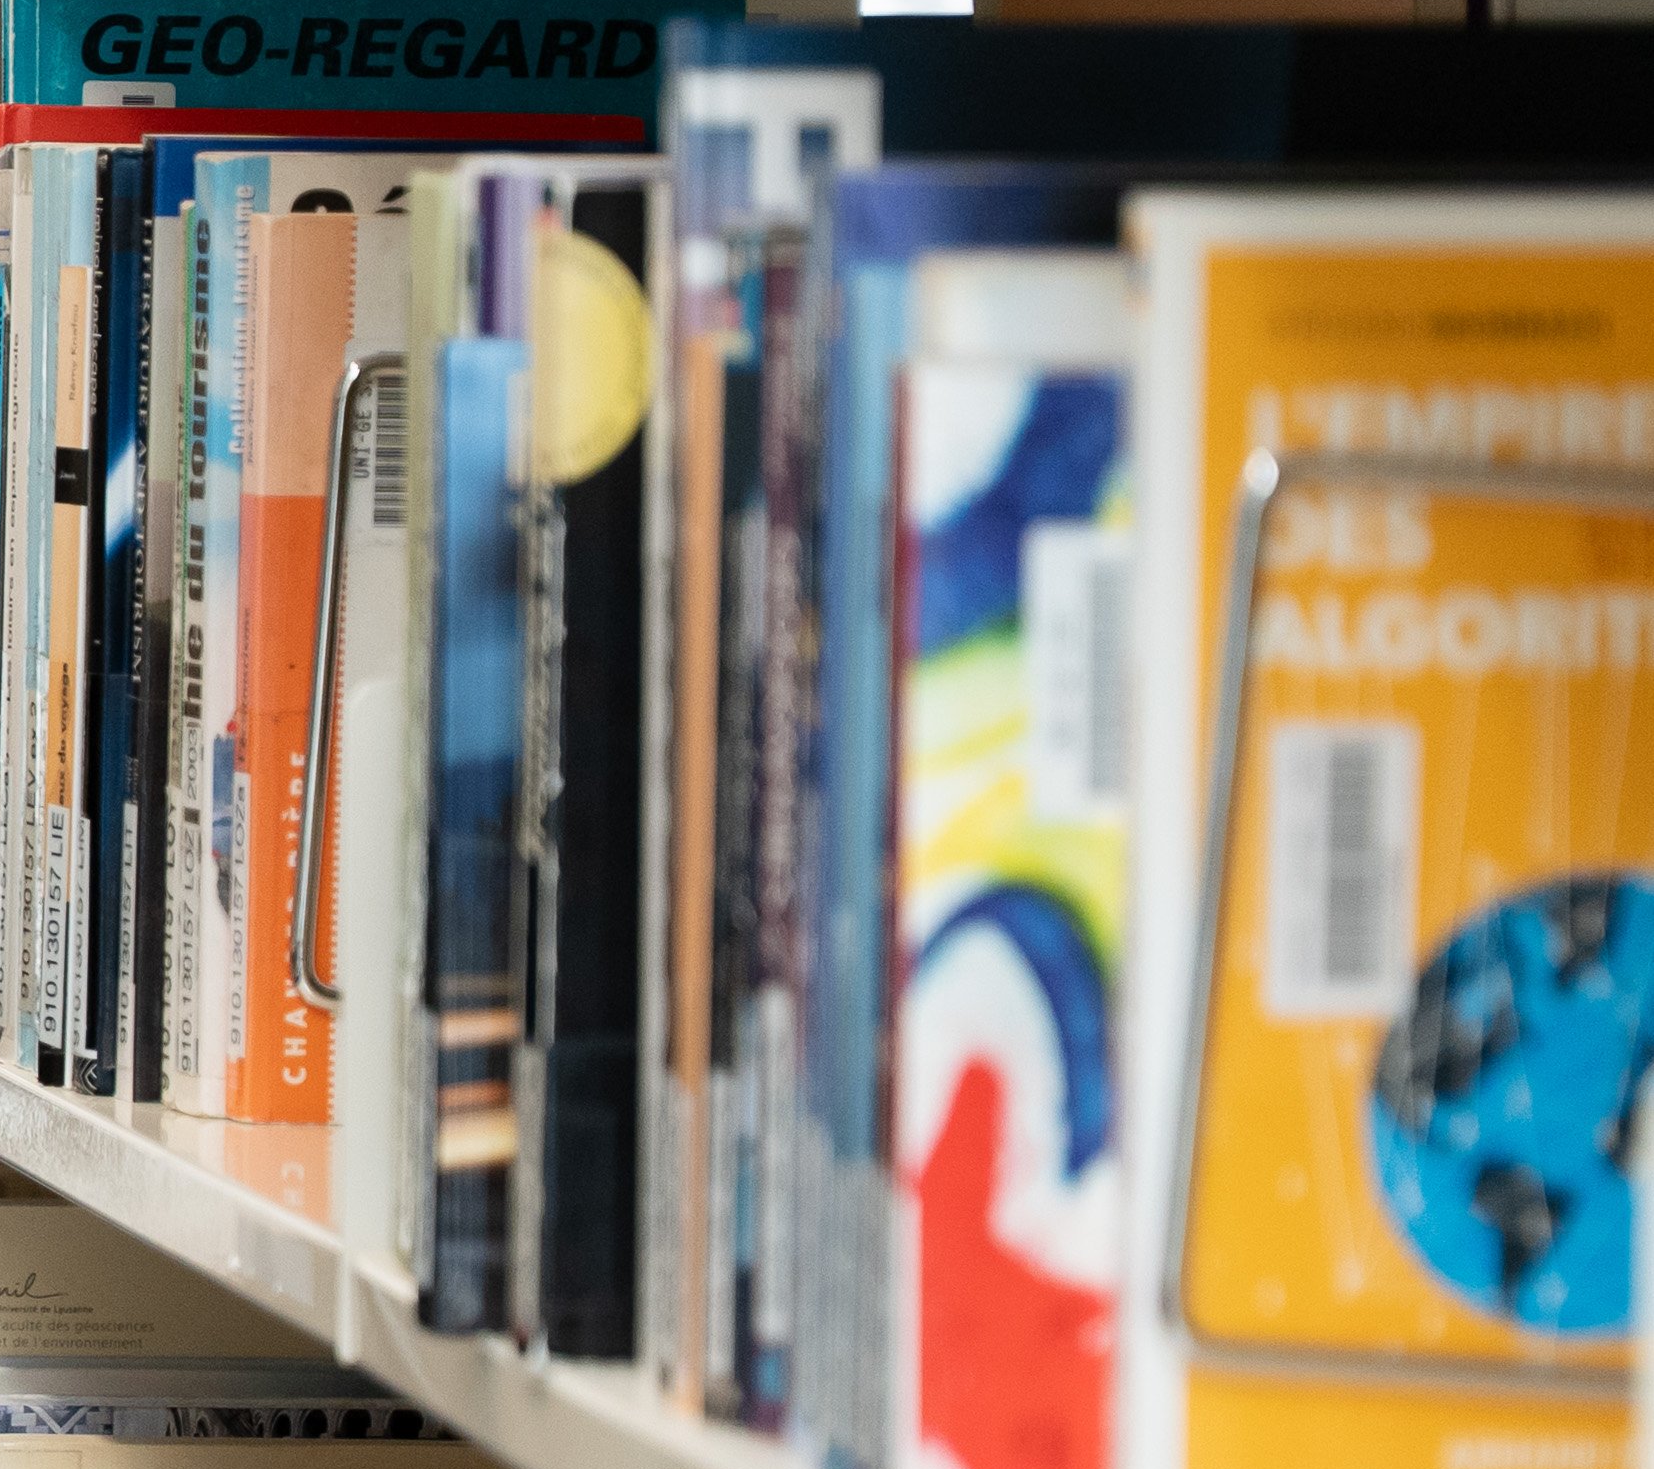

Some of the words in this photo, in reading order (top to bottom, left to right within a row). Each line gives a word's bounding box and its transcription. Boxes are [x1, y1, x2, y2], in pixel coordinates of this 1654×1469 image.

[81, 14, 657, 80] GEO-REGARD
[93, 196, 106, 275] Liminal
[88, 284, 103, 416] Landscapes
[136, 217, 153, 428] LITERATURE
[185, 217, 214, 500] tourisme
[9, 331, 22, 431] agricole
[8, 439, 20, 527] espace
[134, 437, 147, 517] AND
[184, 523, 207, 601] du
[5, 575, 15, 649] loisirs
[130, 531, 145, 684] TOURISM
[25, 765, 37, 827] LEV
[184, 728, 200, 800] 2003
[49, 812, 65, 858] LIE
[122, 822, 134, 867] LIT
[181, 827, 197, 891] LOZ
[233, 784, 248, 864] LOZa
[19, 835, 35, 998] 910.130157
[42, 866, 64, 1032] 910.130157
[177, 904, 197, 1072] 910.130157
[228, 872, 247, 1045] 910.130157
[12, 1336, 29, 1348] de
[40, 1304, 51, 1314] de
[47, 1319, 70, 1331] des
[75, 1320, 155, 1335] géosciences
